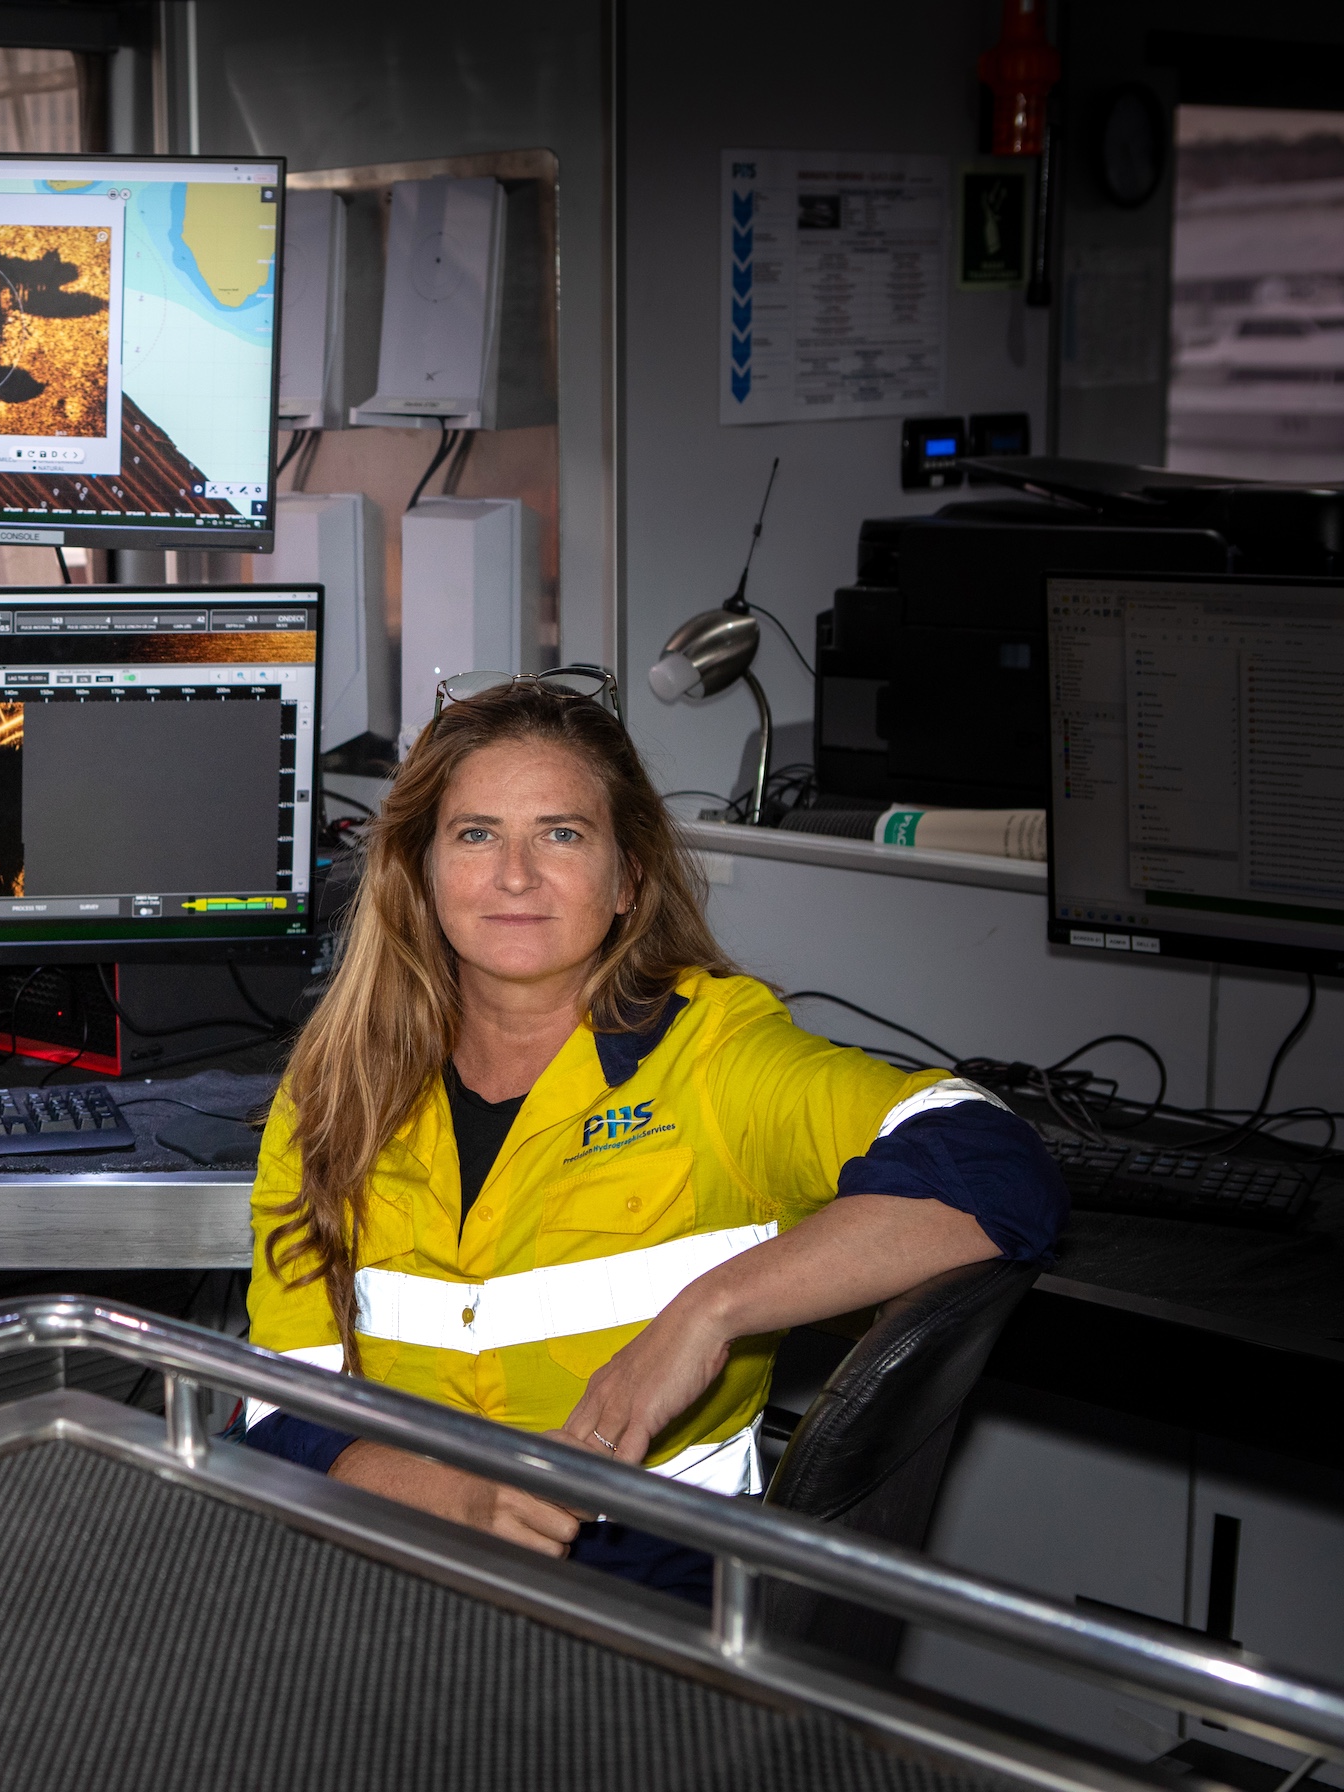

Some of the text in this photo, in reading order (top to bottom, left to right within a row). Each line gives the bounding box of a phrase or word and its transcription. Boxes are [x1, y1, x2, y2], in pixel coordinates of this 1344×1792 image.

[0, 532, 40, 540] CONSOLE
[582, 1098, 656, 1147] PHS
[563, 1123, 676, 1165] Precision Hydrographic Services
